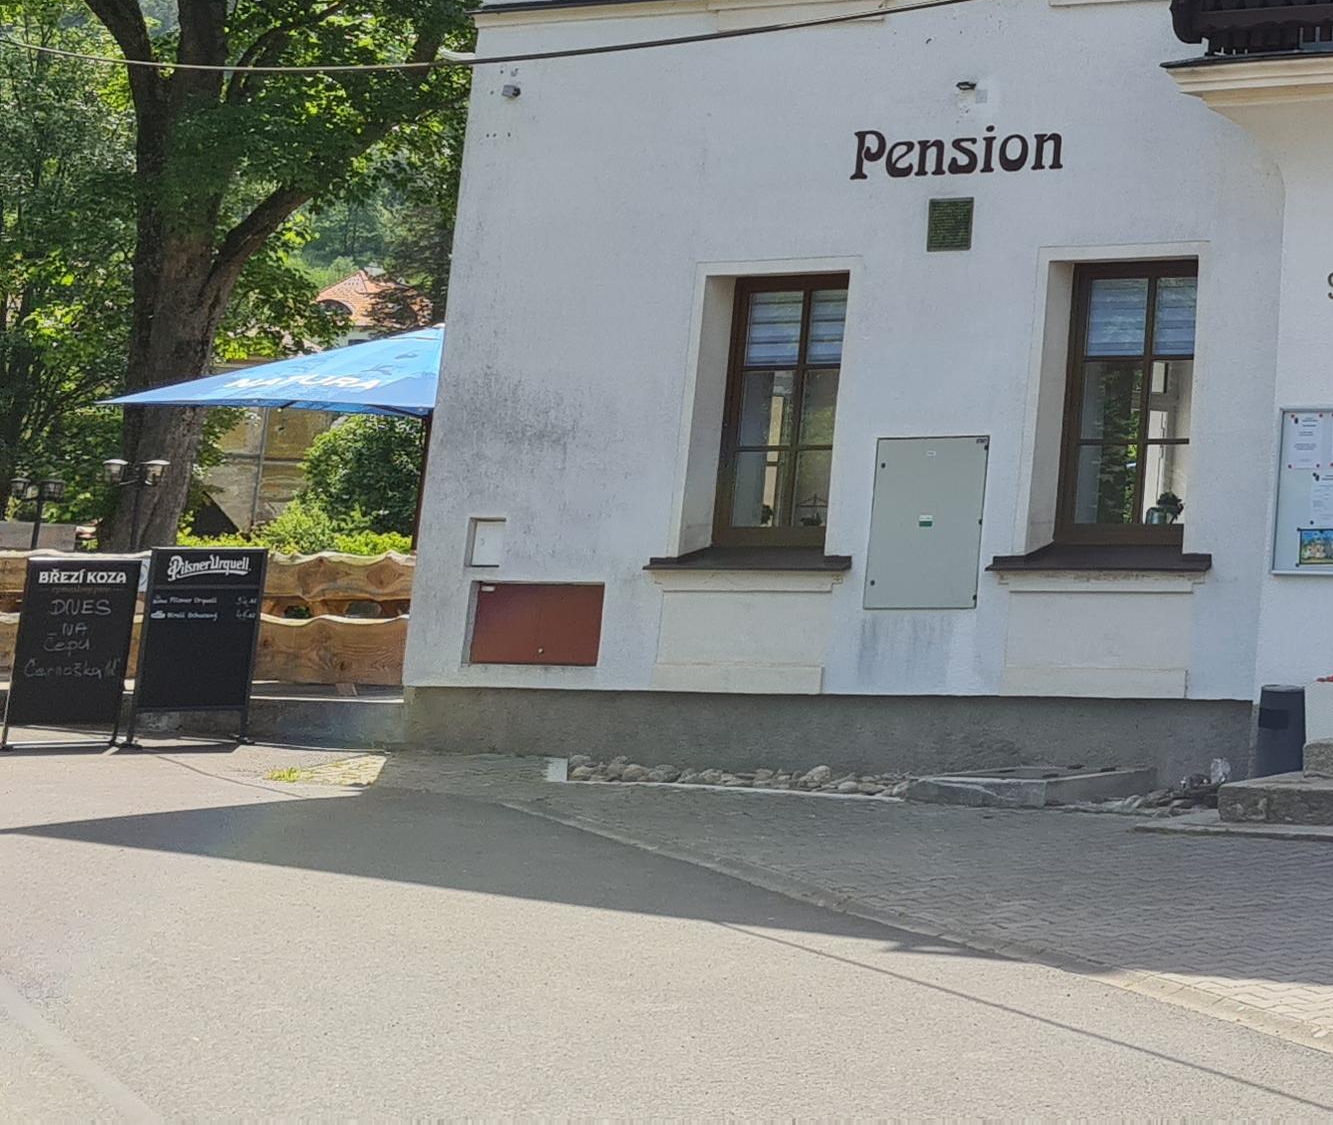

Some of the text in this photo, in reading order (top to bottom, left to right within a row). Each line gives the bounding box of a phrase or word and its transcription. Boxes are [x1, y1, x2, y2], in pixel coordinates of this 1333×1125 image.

[849, 124, 1064, 180] Pension
[38, 568, 127, 584] BŘEZÍ KOZA
[167, 554, 250, 582] Pilsner Urquell
[50, 598, 112, 616] DNES
[62, 621, 88, 636] NA
